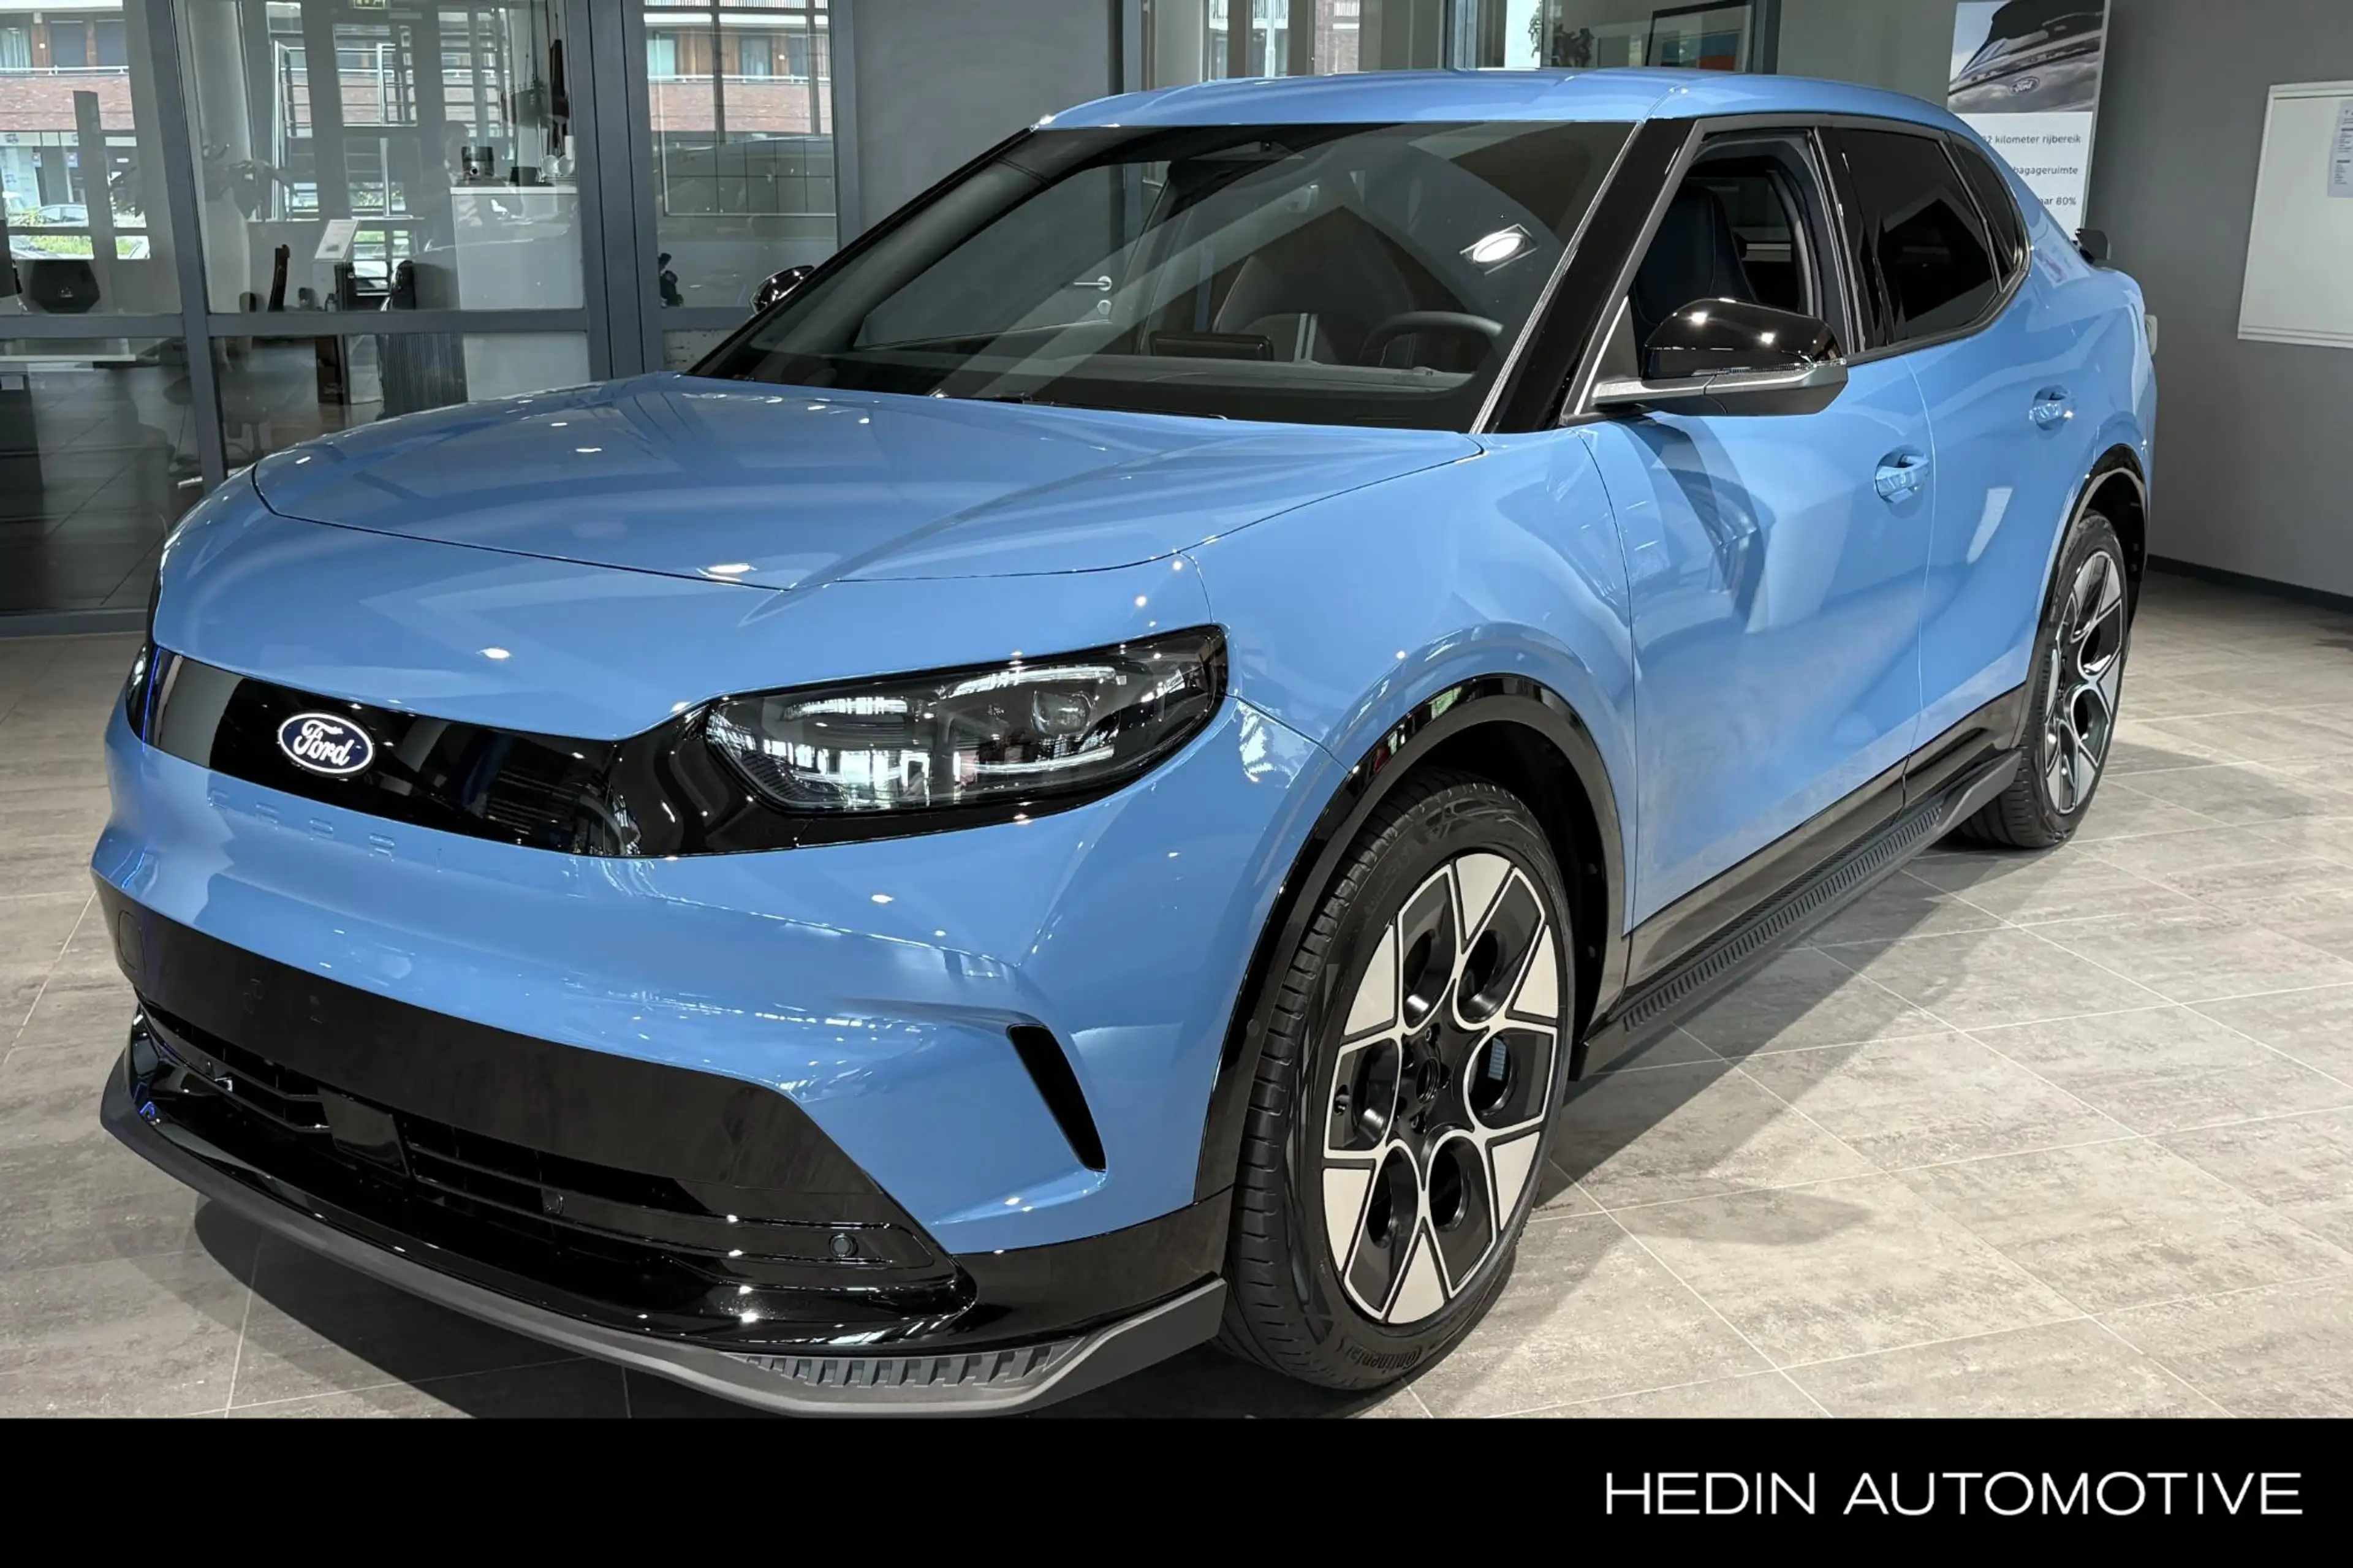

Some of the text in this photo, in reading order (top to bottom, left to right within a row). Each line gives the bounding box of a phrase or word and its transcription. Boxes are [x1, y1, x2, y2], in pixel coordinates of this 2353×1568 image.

[1995, 134, 2040, 143] kilometer
[2042, 134, 2081, 146] rijbereik
[2056, 195, 2077, 205] 80%
[292, 719, 355, 766] Ford
